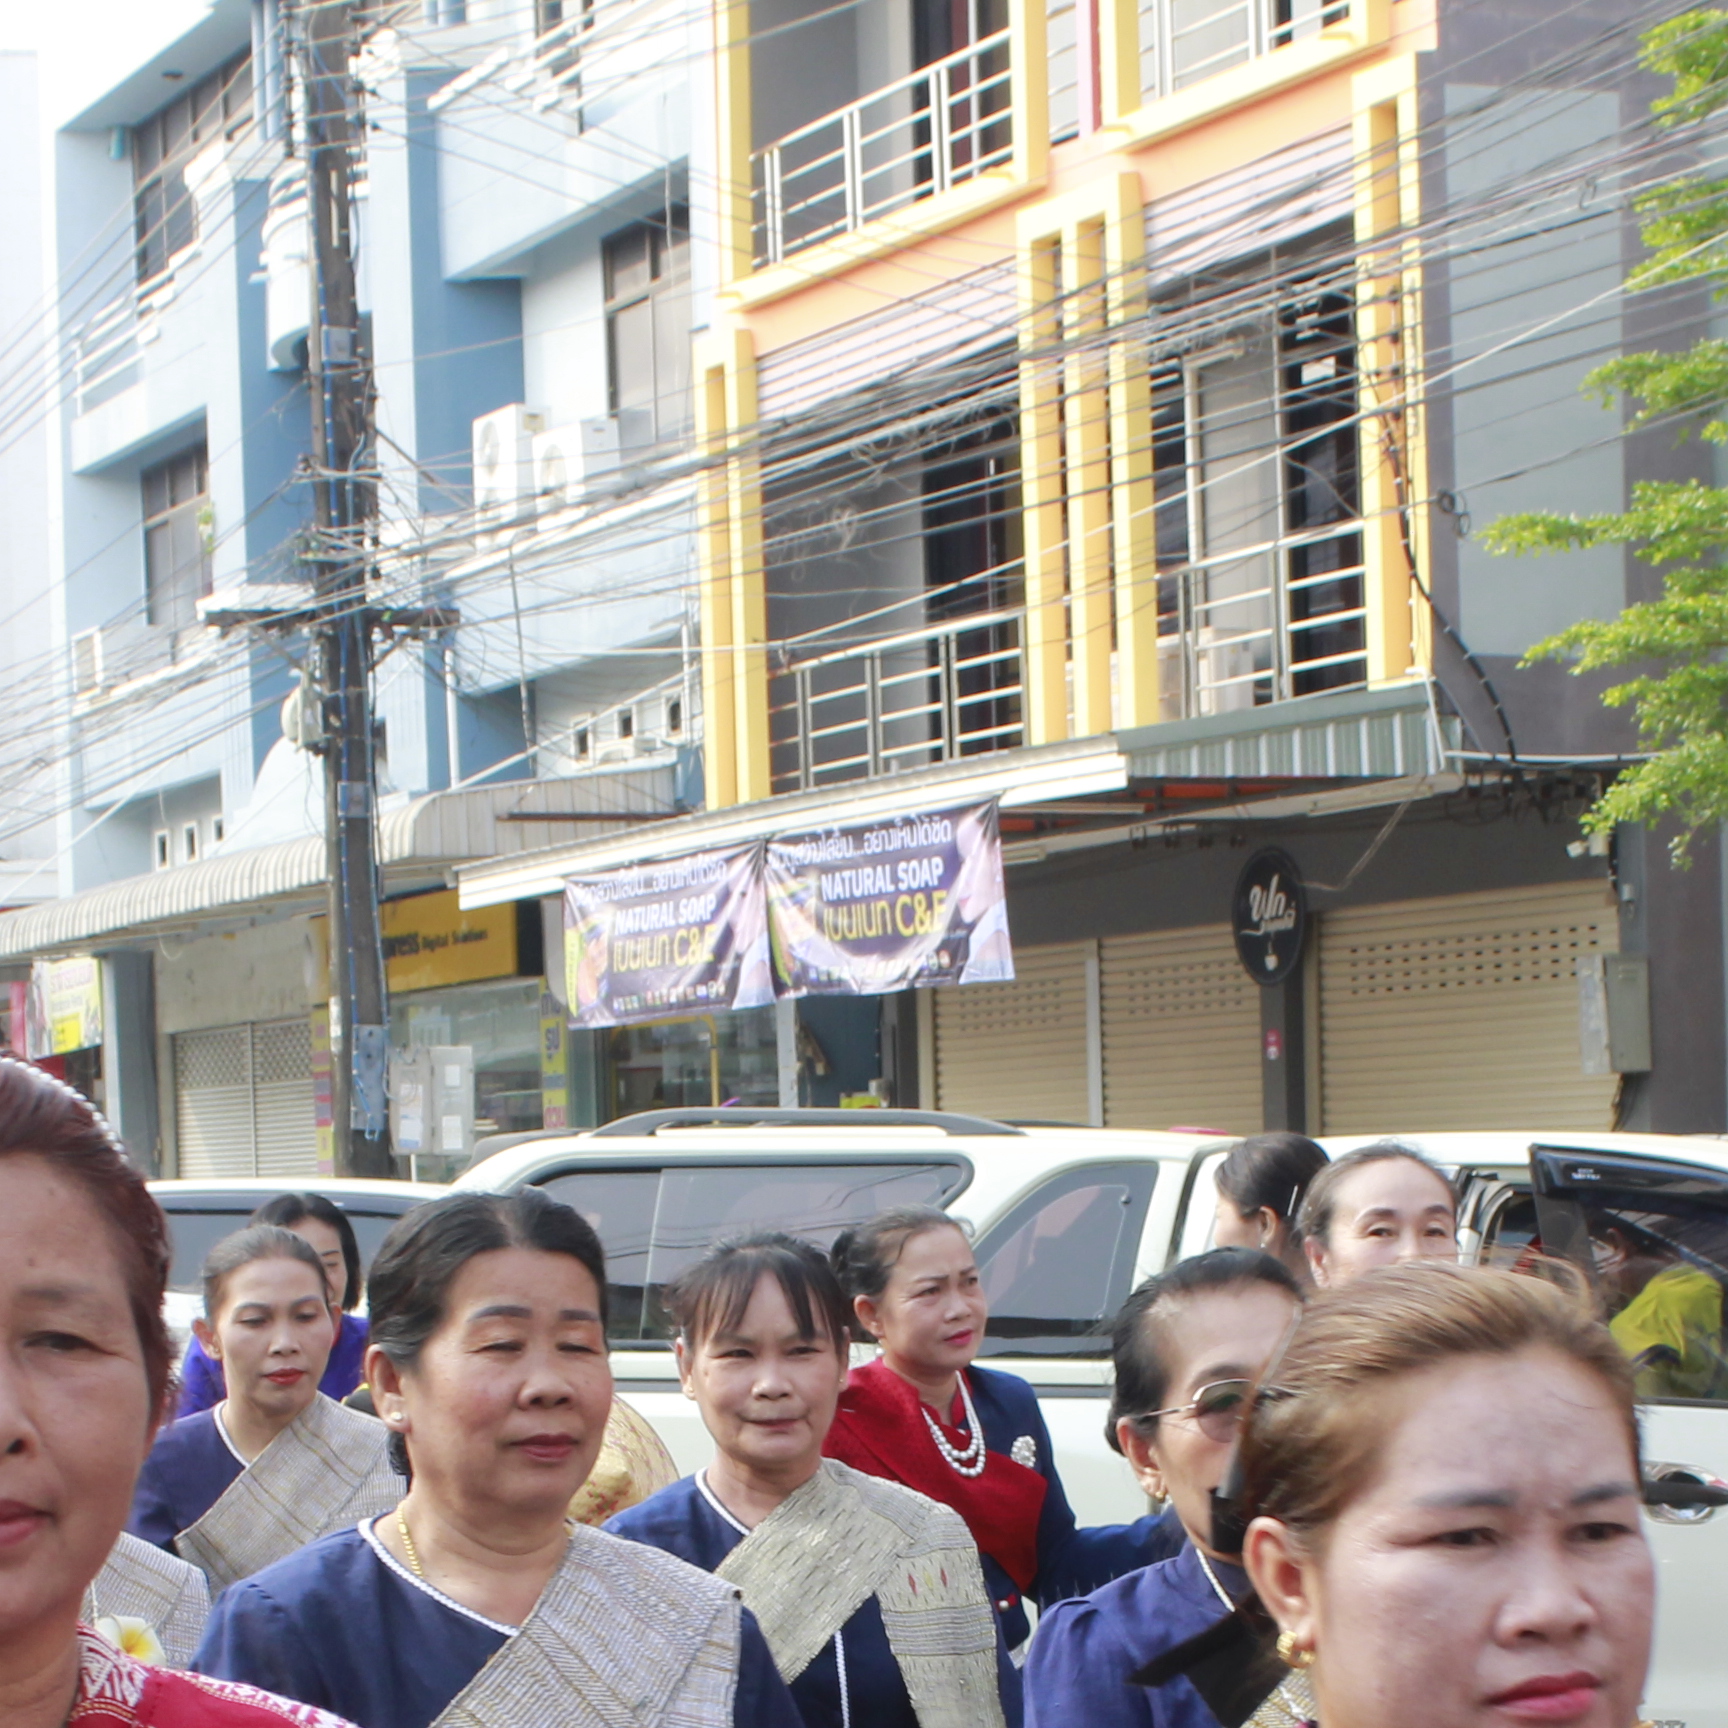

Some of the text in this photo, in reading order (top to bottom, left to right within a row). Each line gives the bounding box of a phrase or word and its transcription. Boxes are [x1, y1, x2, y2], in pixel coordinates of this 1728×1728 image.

[821, 856, 945, 902] NATURAL SOAP
[615, 893, 717, 936] NATURAL SOAP
[894, 889, 949, 938] C&E
